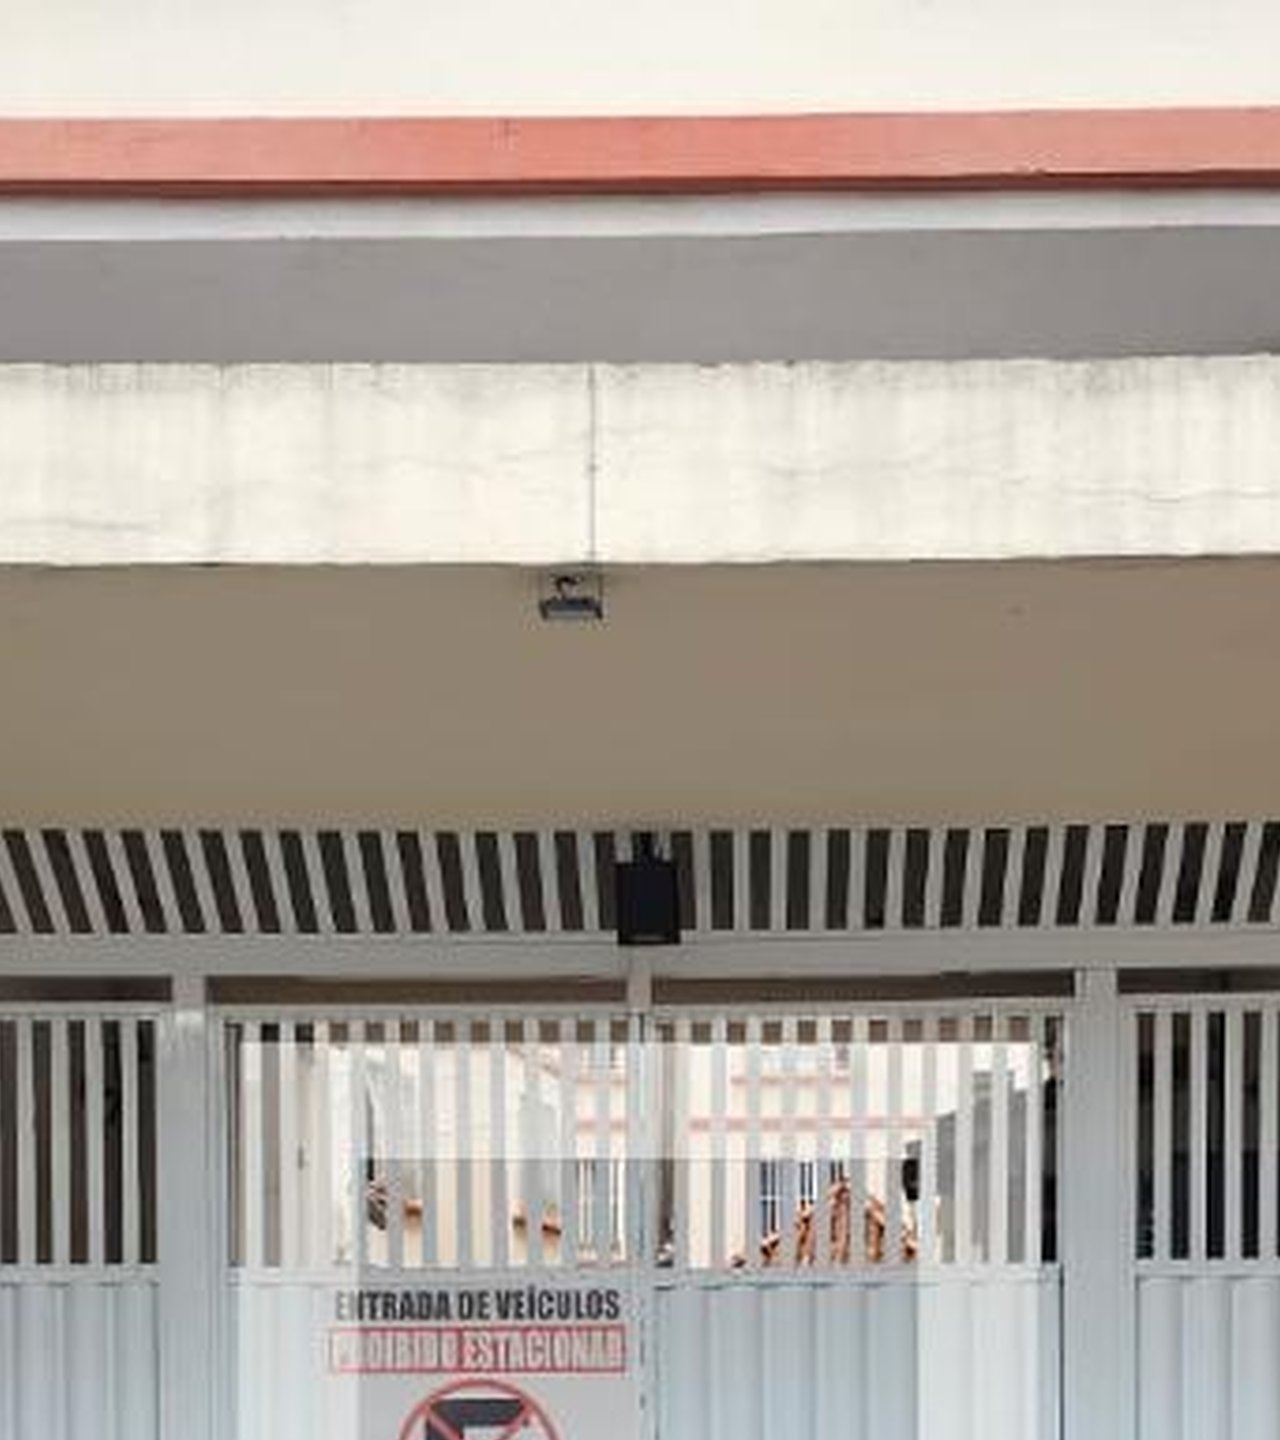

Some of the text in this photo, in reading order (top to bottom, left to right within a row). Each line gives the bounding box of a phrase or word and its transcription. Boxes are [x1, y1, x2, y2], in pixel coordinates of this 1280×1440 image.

[336, 1284, 620, 1322] ENTRADA DE VEÍCULOS
